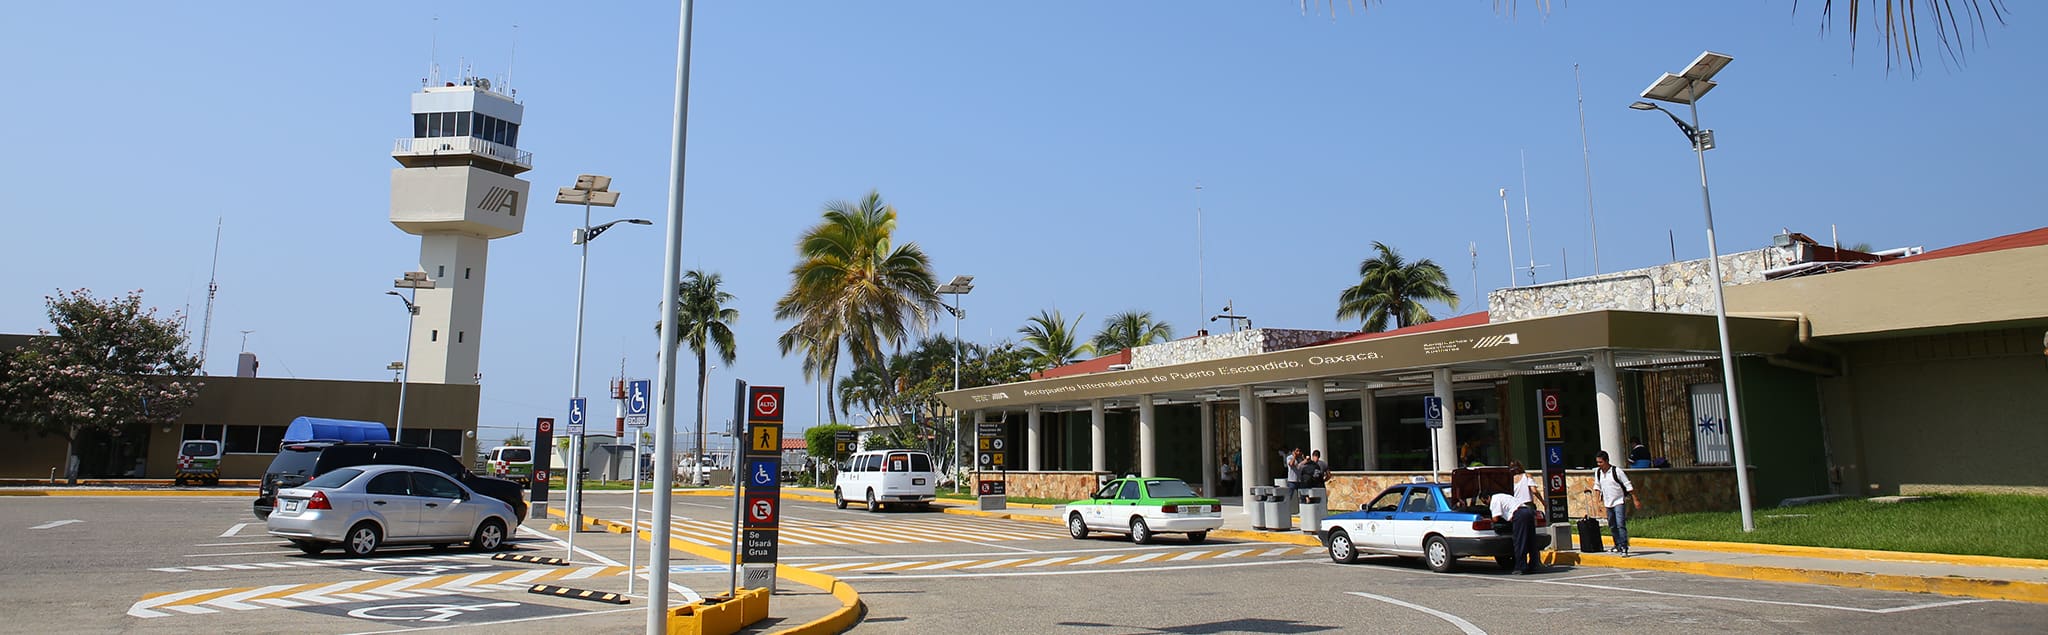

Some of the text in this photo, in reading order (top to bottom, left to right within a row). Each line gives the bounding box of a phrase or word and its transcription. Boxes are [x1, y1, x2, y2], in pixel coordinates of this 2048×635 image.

[1023, 351, 1384, 397] Aeropuerto Internacional de Puerto Escondido, Oaxaca.
[749, 531, 760, 539] Se
[748, 539, 772, 547] Usará
[748, 548, 768, 556] Grua
